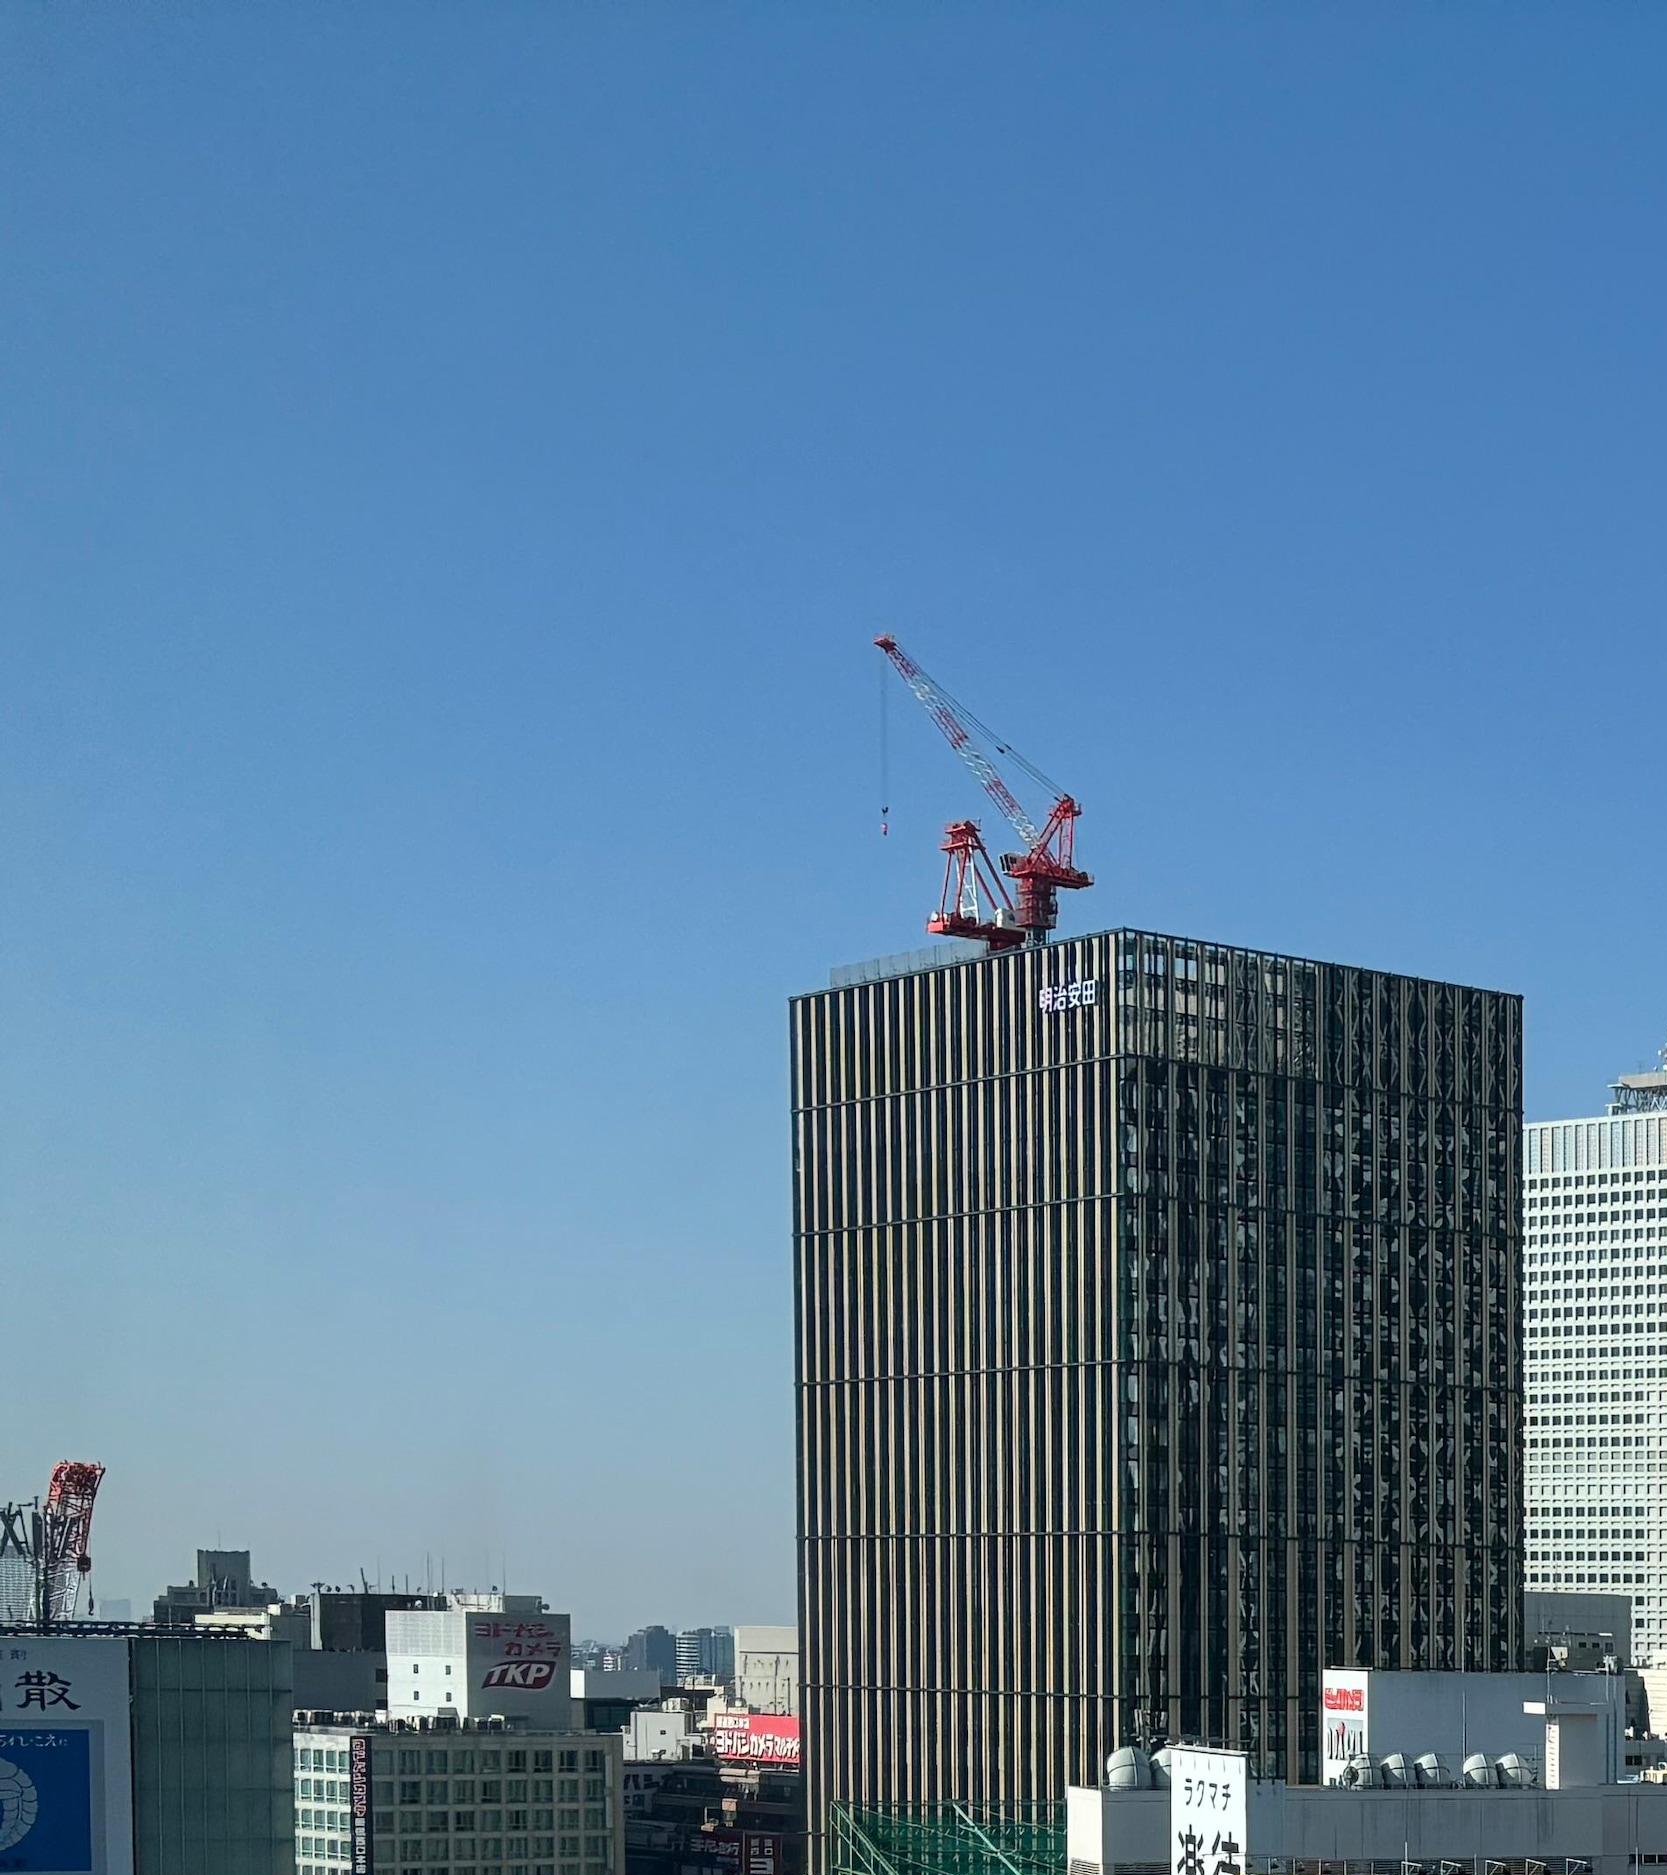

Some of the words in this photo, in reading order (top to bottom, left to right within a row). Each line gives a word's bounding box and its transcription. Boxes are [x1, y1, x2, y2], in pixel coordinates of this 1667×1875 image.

[1039, 978, 1098, 1013] 明治安田
[489, 1662, 550, 1685] TKP
[1184, 1778, 1231, 1811] ラクマチ
